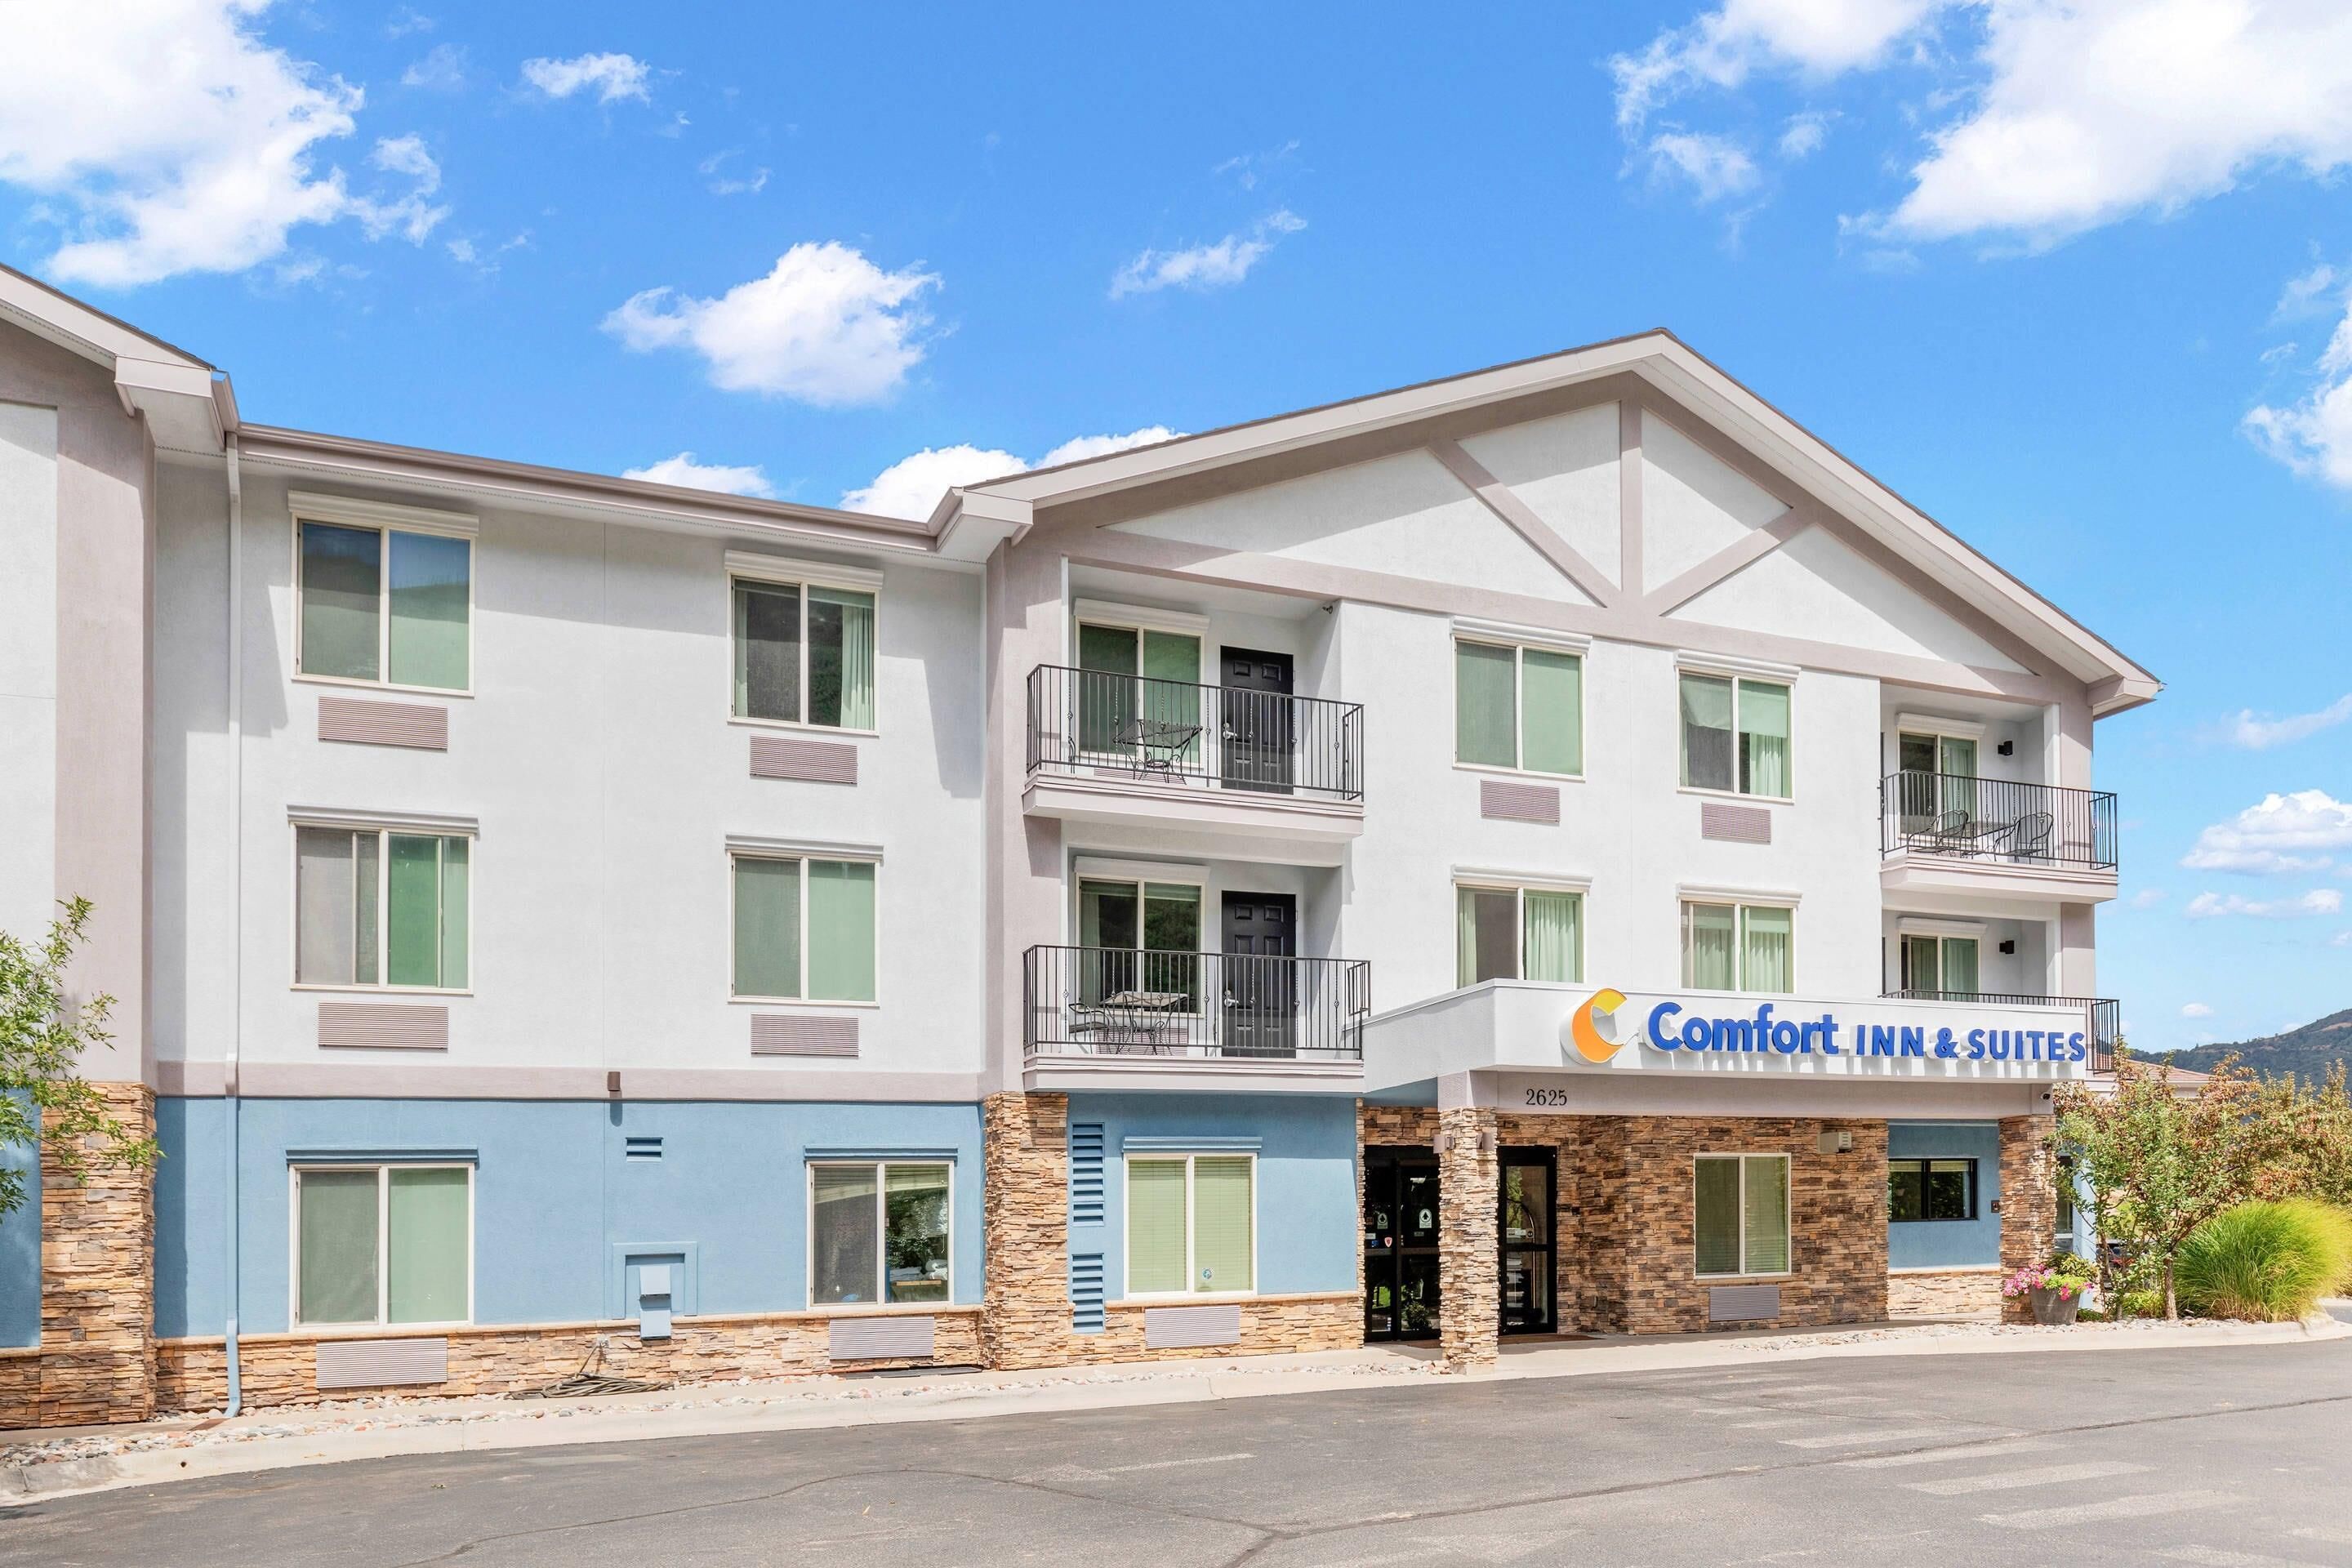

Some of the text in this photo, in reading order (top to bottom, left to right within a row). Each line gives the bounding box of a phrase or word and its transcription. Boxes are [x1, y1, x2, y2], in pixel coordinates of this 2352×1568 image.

[1647, 1001, 2086, 1062] Comfort INN & SUITES
[1526, 1088, 1567, 1107] 2625
